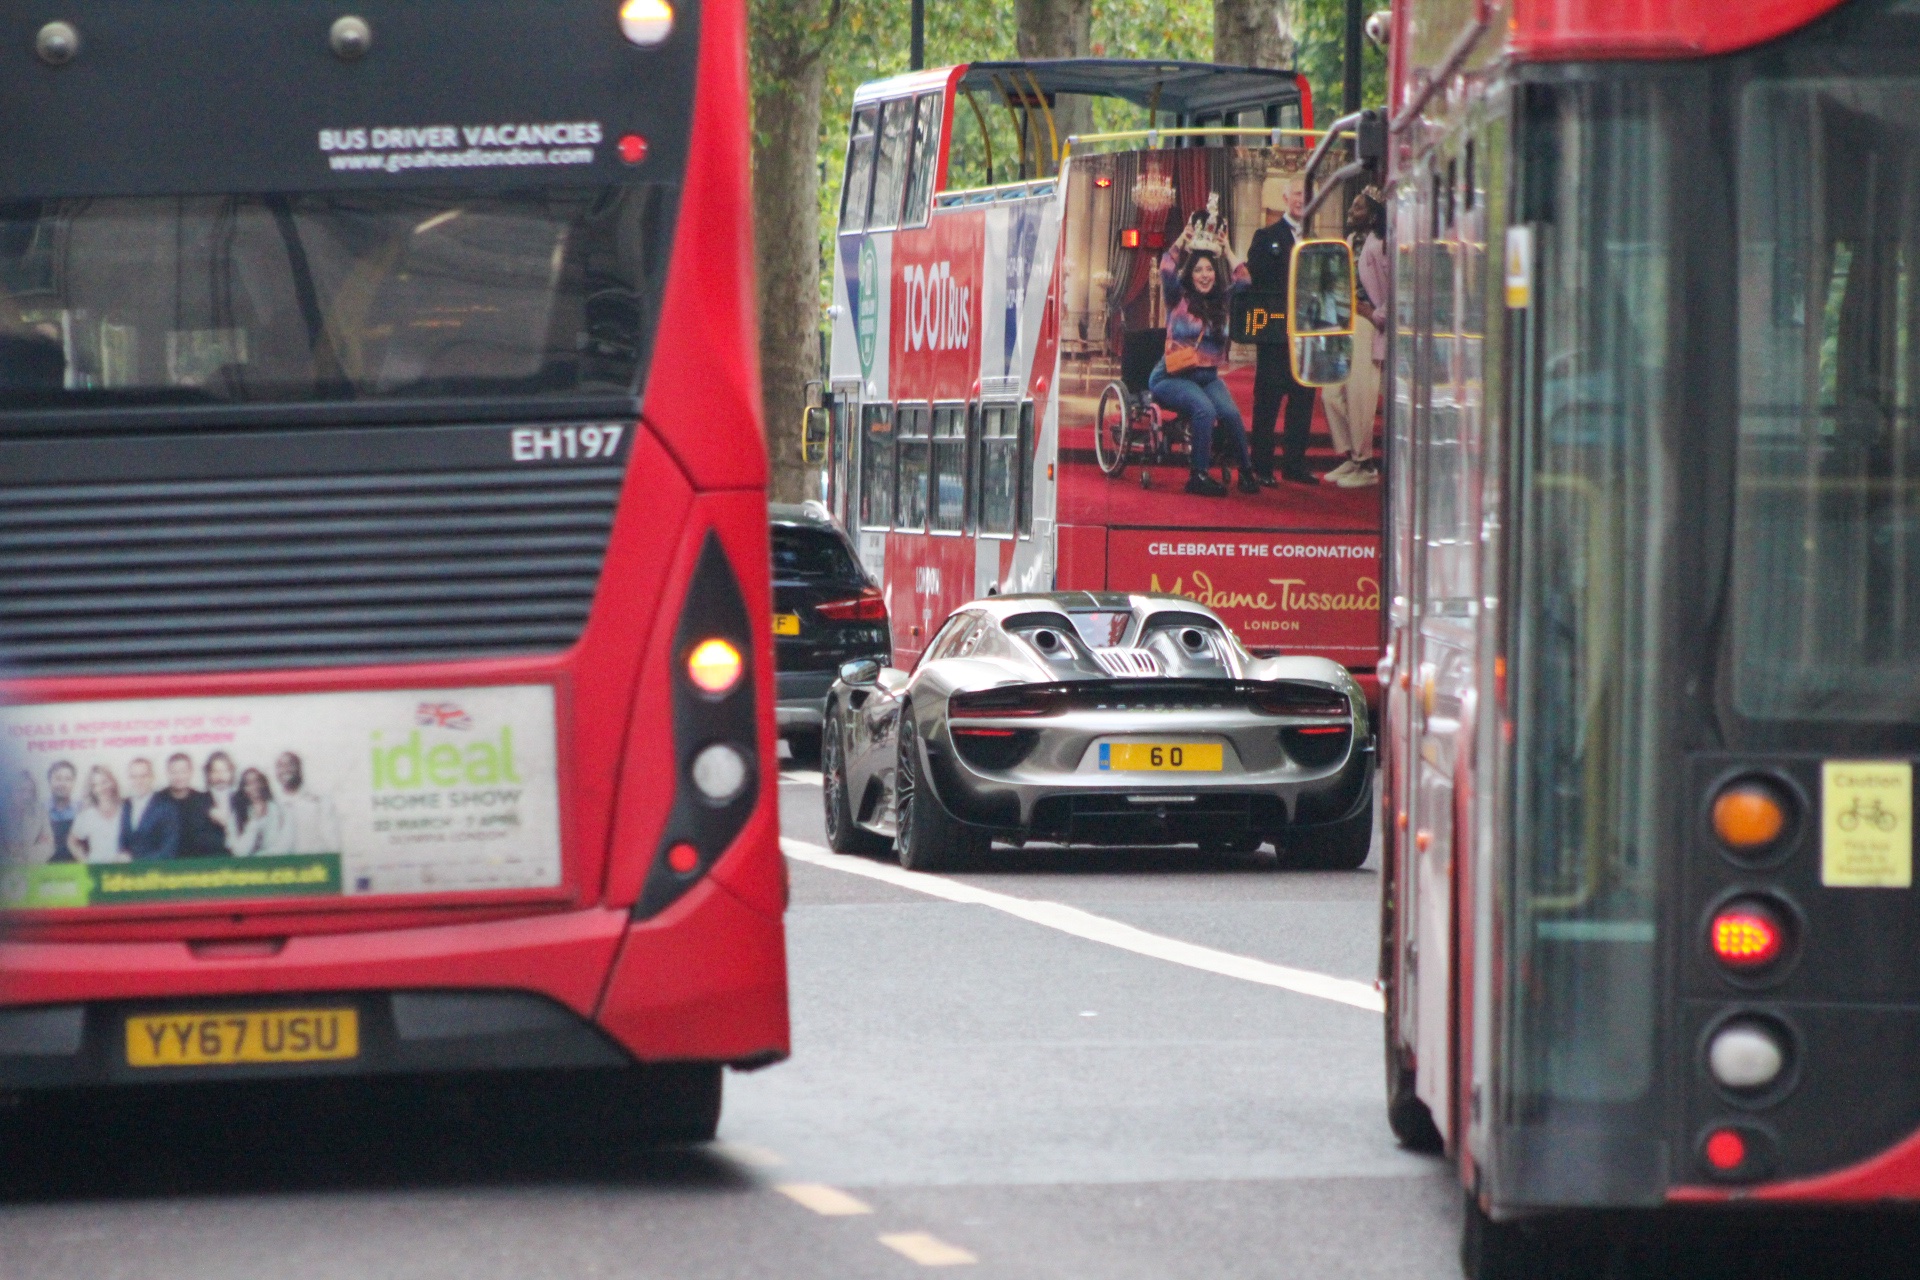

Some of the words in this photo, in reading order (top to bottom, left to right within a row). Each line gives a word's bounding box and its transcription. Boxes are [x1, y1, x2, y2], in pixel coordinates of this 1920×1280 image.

[318, 129, 367, 150] BUS
[371, 127, 460, 148] DRIVER
[462, 122, 602, 146] VACANCIES
[328, 148, 595, 172] www.goaheadlondon.com
[511, 425, 624, 461] EH197
[1148, 542, 1235, 556] CELEBRATE
[1239, 544, 1269, 556] THE
[1272, 545, 1376, 559] CORONATION
[1244, 620, 1300, 630] LONDON
[370, 725, 522, 790] ideal
[371, 792, 440, 810] HOME
[449, 790, 522, 808] SHOW
[145, 1018, 247, 1057] YY67
[260, 1016, 339, 1053] USU
